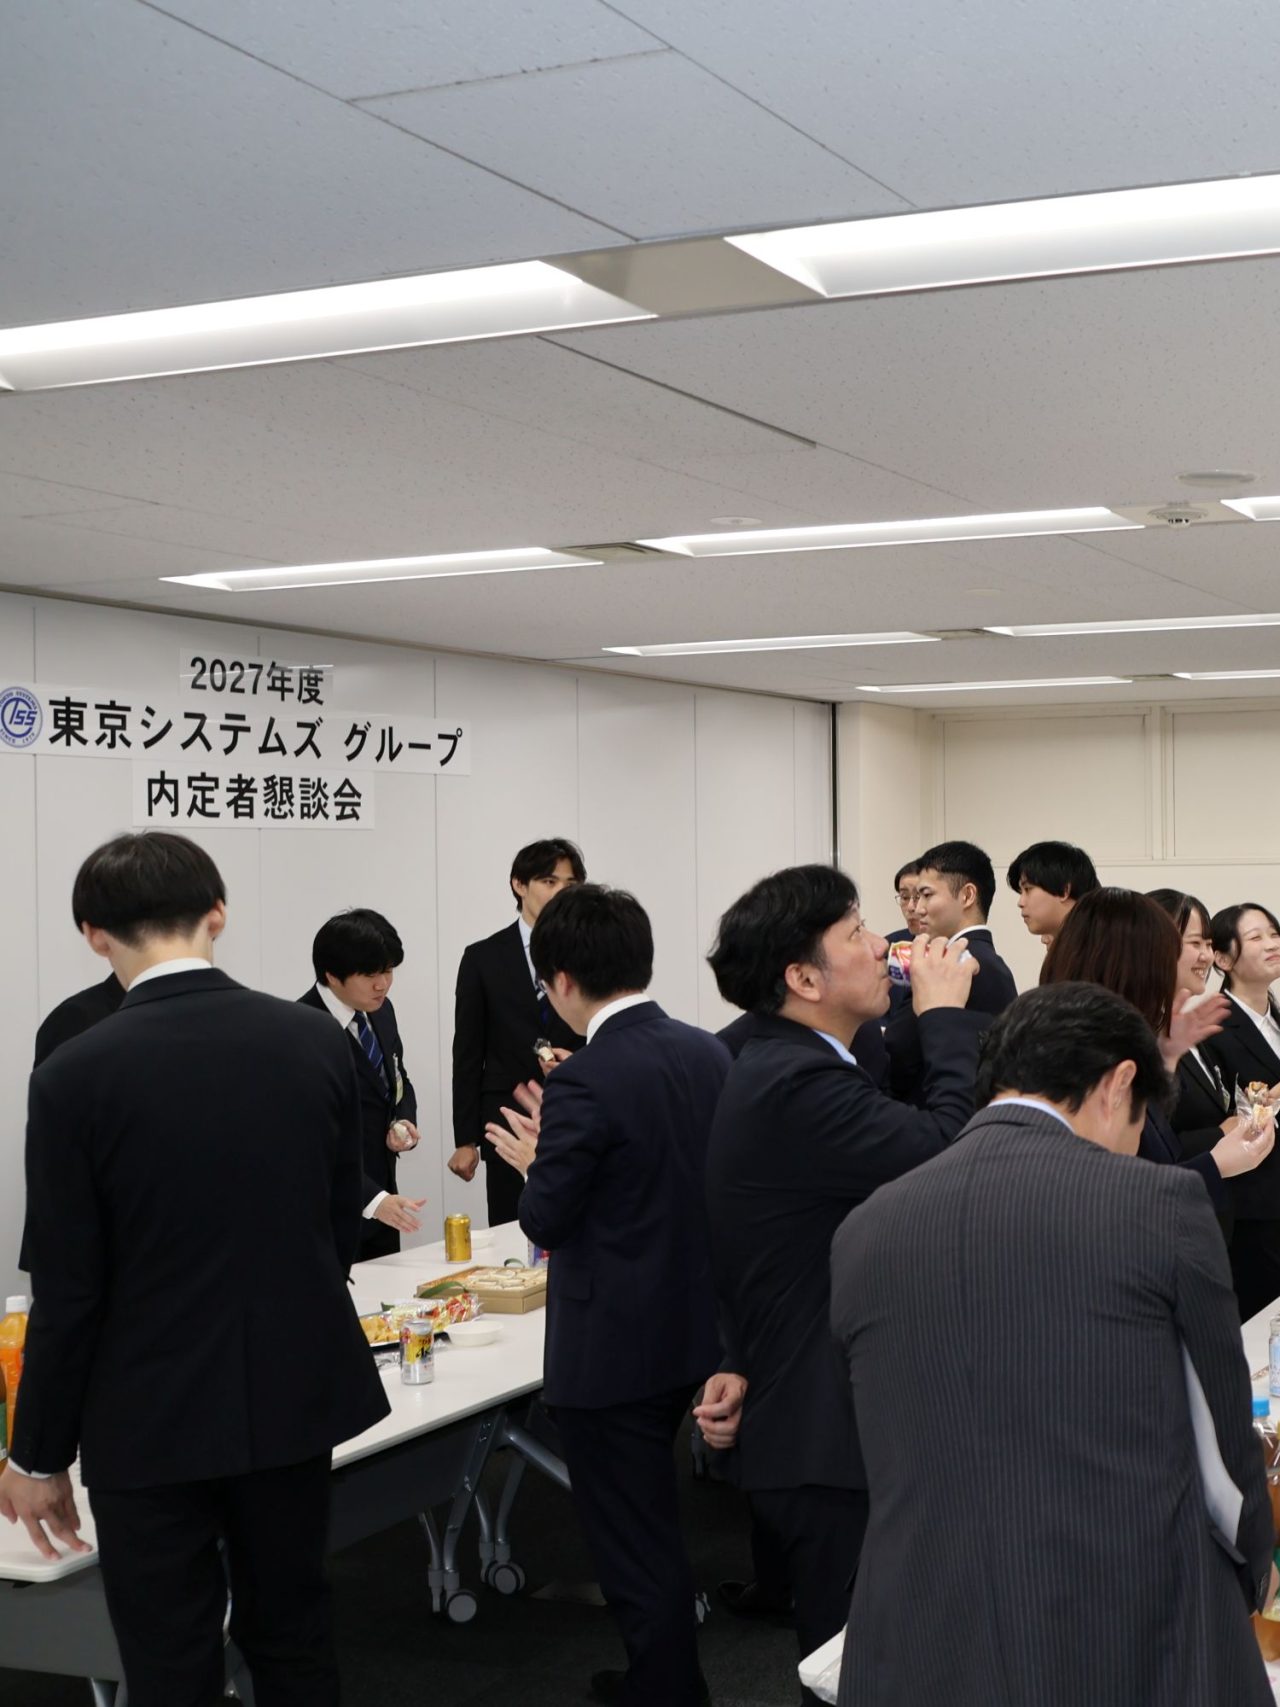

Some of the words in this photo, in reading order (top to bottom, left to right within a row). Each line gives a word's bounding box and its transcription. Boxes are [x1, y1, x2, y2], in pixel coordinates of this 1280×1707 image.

[190, 656, 324, 706] 2027年度
[147, 770, 362, 821] 内定者懇談会
